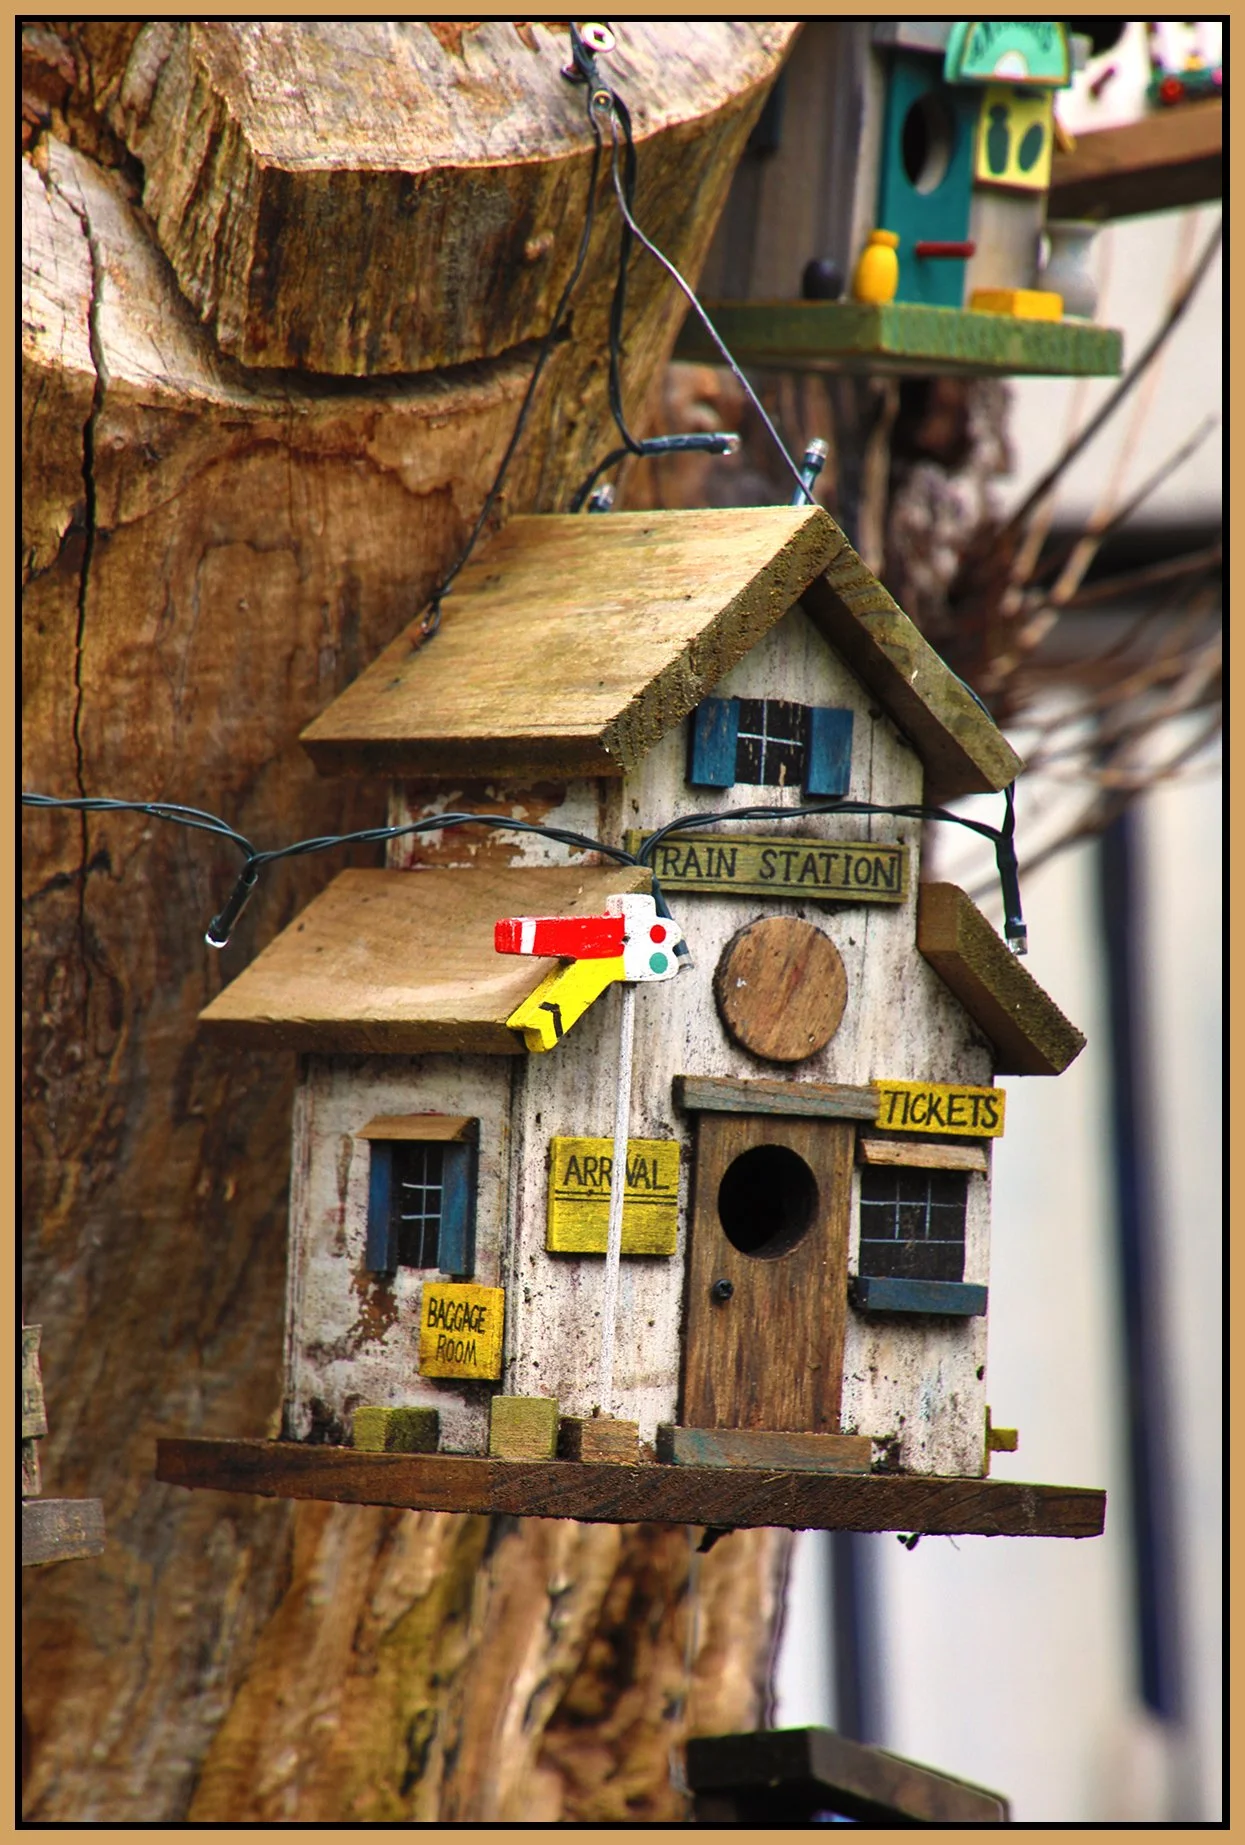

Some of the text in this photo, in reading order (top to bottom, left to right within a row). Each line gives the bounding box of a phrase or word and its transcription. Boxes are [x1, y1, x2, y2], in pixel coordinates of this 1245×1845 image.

[759, 848, 897, 888] STATION
[883, 1089, 999, 1129] TICKETS
[562, 1153, 671, 1190] ARRVAL
[427, 1297, 487, 1335] BAGGAGE
[435, 1333, 478, 1367] ROOM
